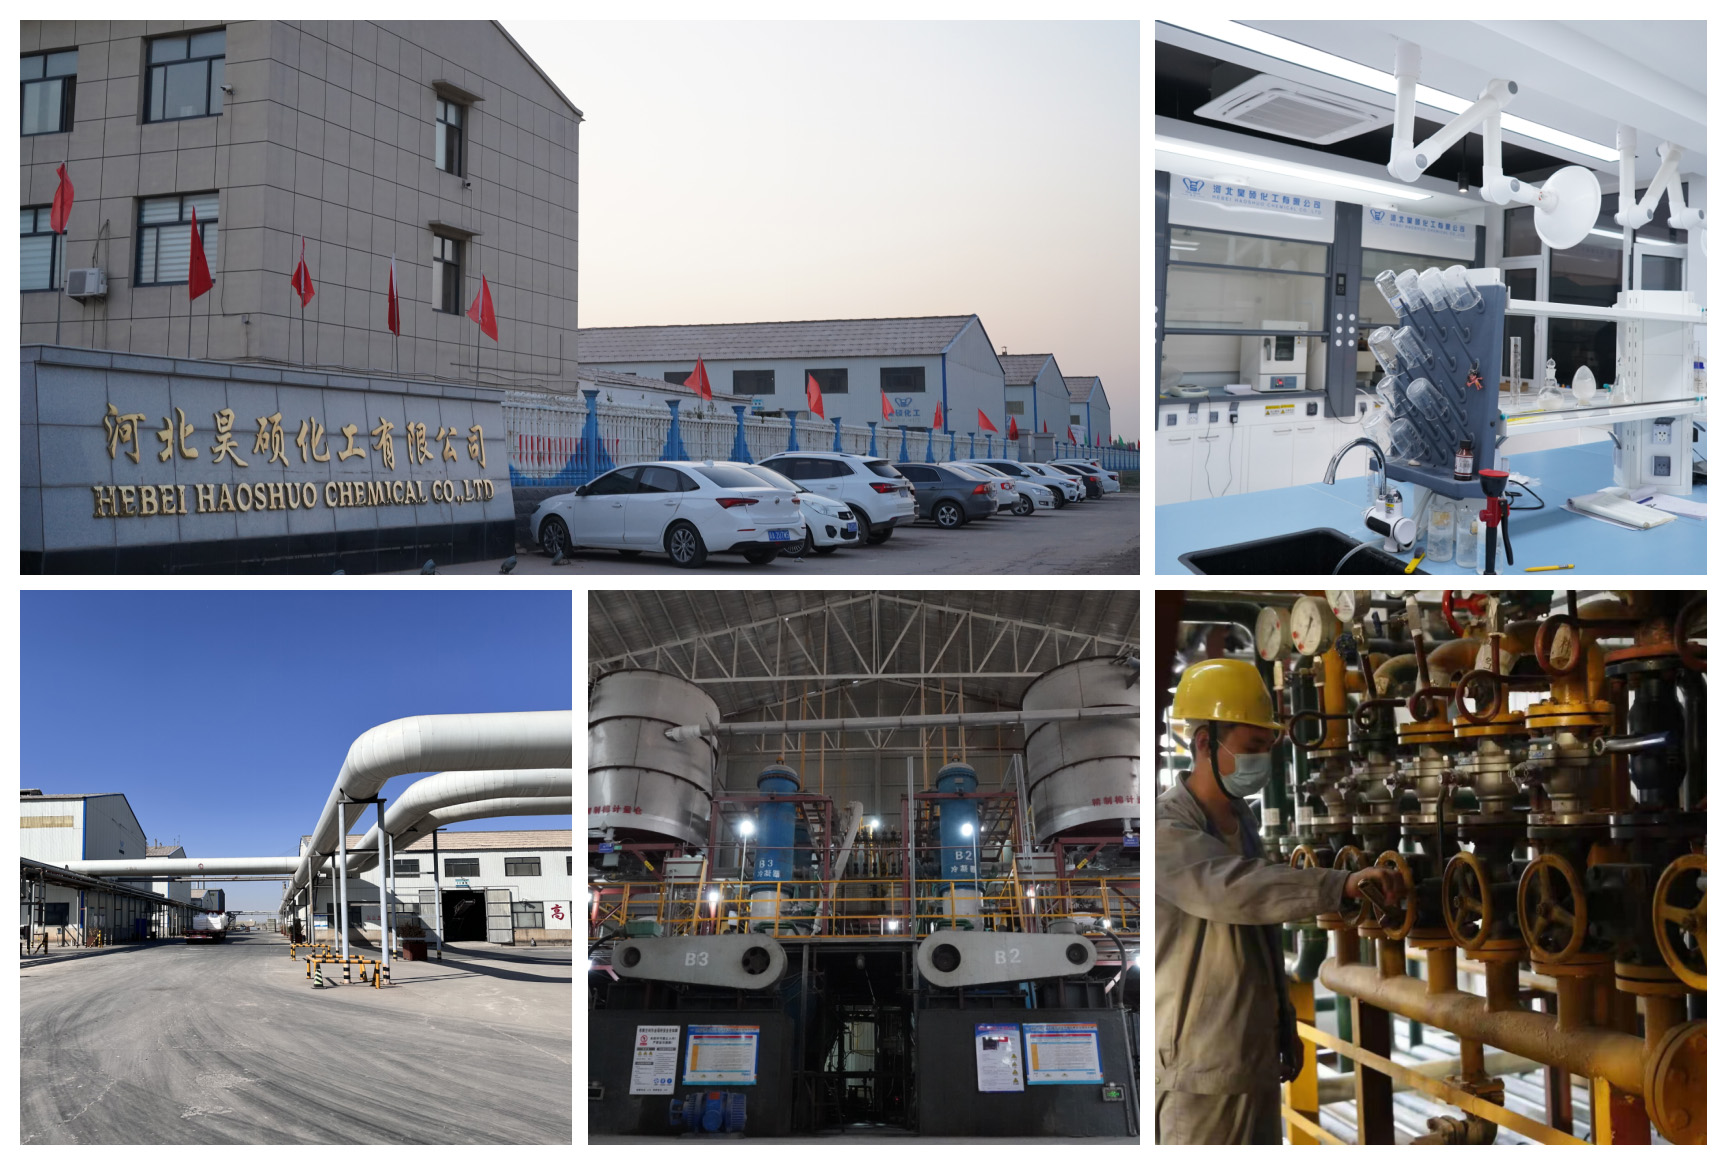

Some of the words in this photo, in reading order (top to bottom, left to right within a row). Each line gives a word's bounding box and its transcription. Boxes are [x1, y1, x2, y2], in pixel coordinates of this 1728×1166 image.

[103, 402, 486, 470] 河北昊硕化工有限公司
[91, 484, 188, 518] HEBEI
[195, 481, 318, 513] HAOSHUO
[325, 480, 428, 508] CHEMICAL
[550, 903, 565, 921] 高
[684, 951, 709, 967] B3
[995, 948, 1022, 965] B2
